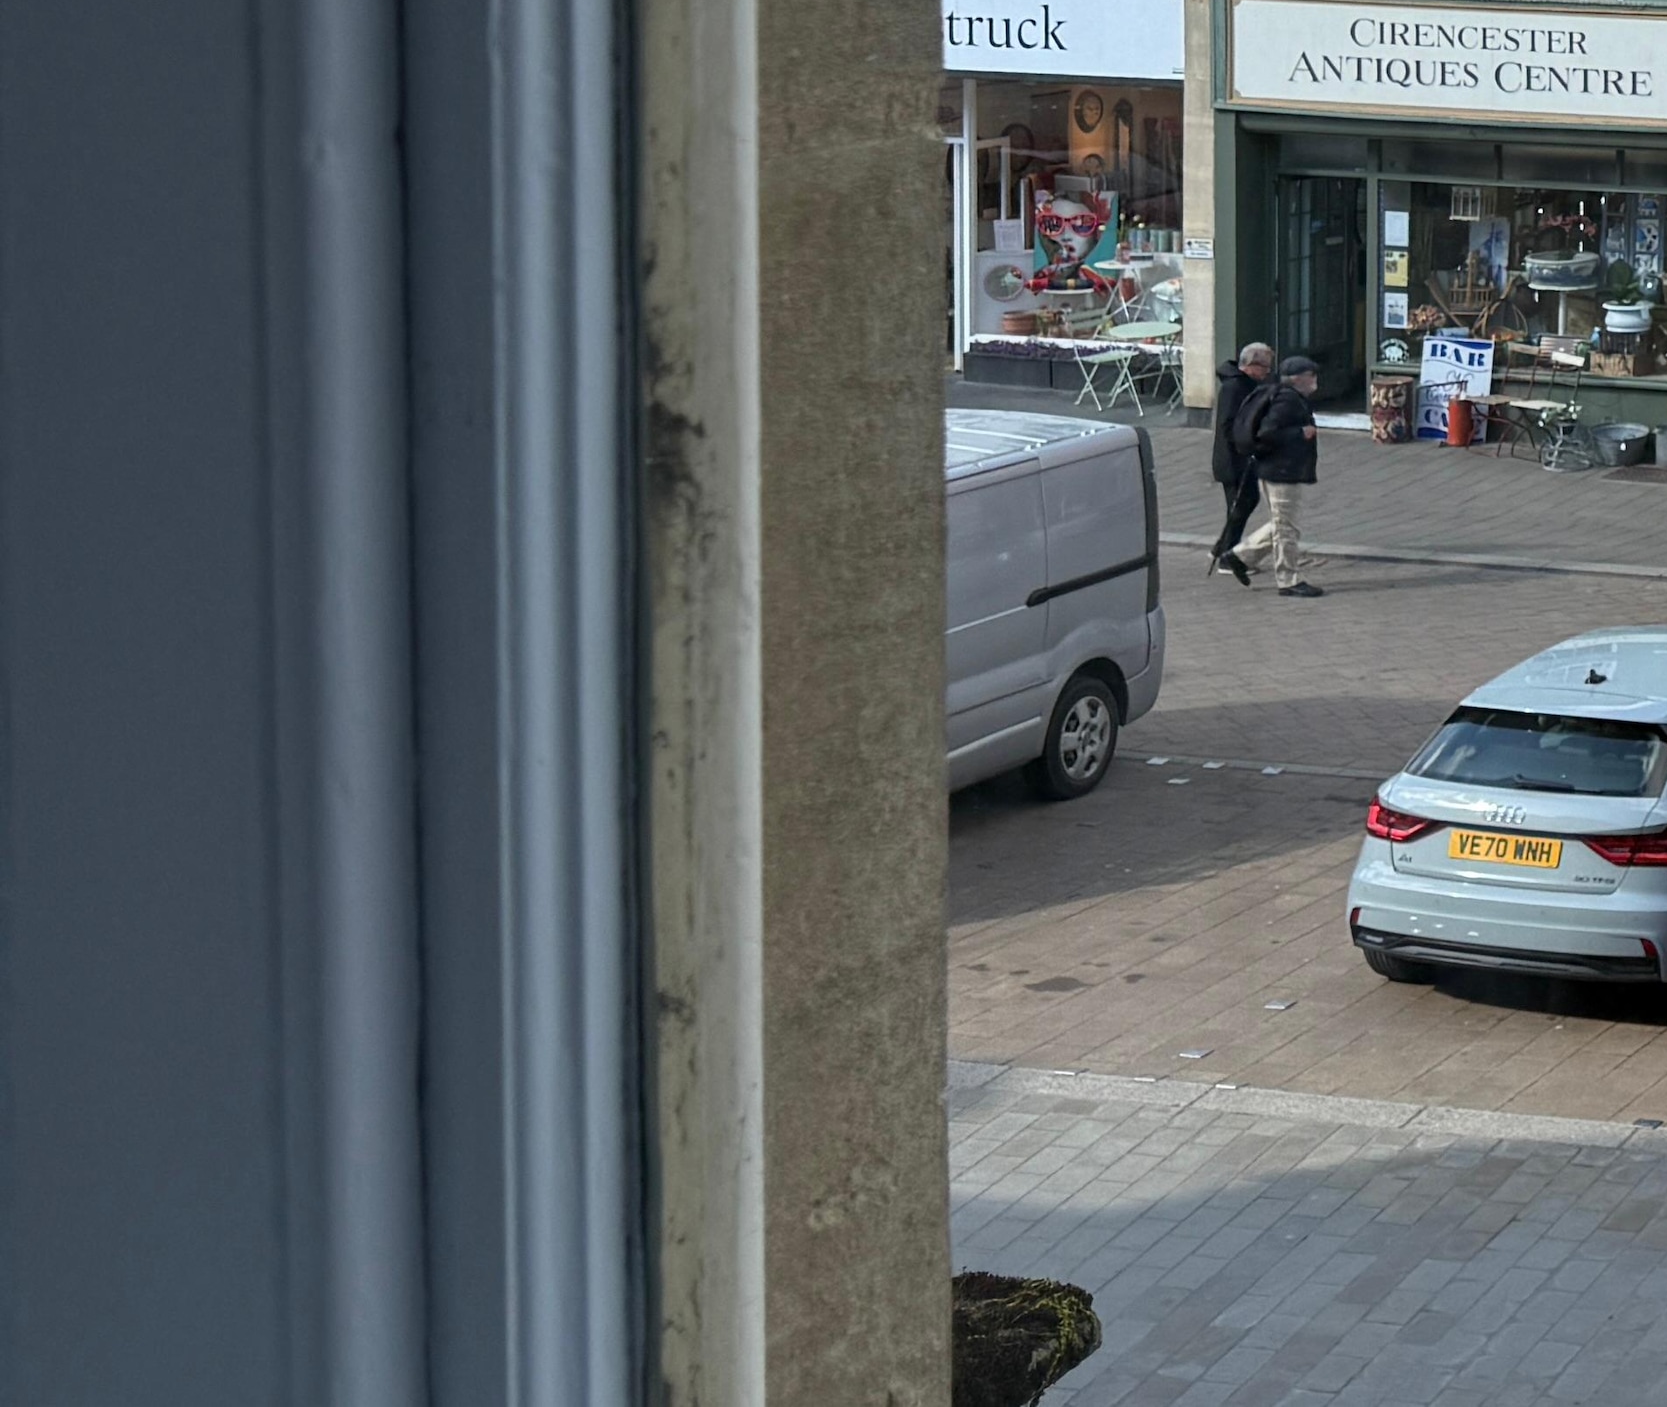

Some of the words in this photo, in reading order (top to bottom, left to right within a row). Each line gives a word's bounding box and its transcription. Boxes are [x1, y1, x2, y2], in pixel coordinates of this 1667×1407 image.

[945, 4, 1068, 51] truck
[1349, 17, 1588, 55] CIRENCESTER
[1288, 51, 1479, 89] ANTIQUES
[1494, 61, 1653, 97] CENTRE
[1430, 343, 1485, 367] BAR
[1458, 833, 1509, 858] VE70
[1512, 839, 1553, 863] WNH
